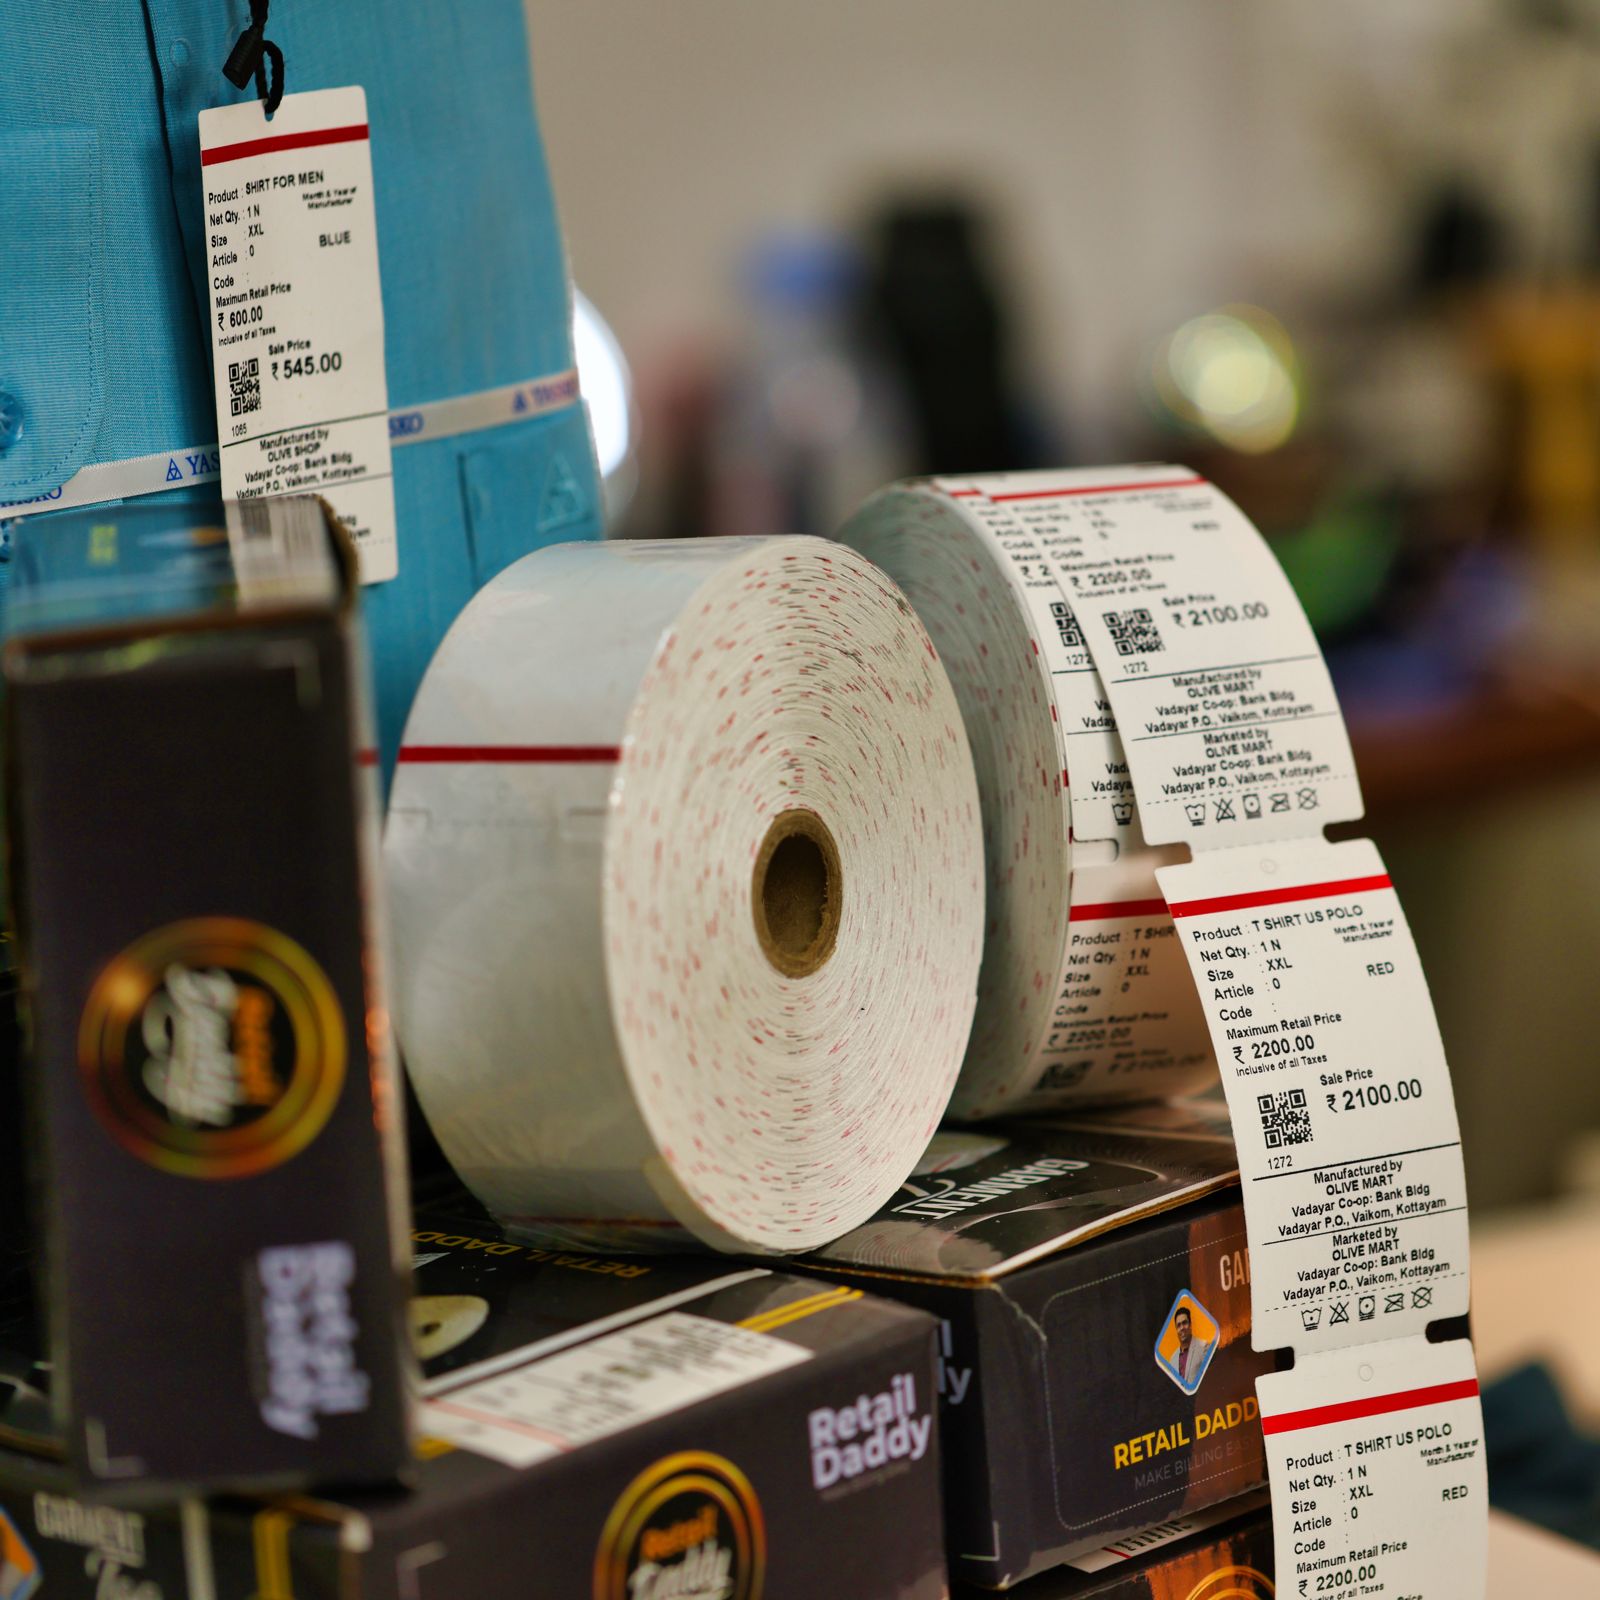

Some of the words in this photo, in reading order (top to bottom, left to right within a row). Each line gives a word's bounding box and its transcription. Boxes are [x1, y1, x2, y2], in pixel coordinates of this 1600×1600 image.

[209, 189, 238, 204] Product
[246, 178, 270, 195] SHIRT
[273, 175, 295, 188] FOR
[299, 171, 324, 185] MEN
[210, 213, 223, 226] Net
[225, 210, 240, 223] Qty.
[248, 207, 251, 218] 1
[254, 205, 260, 217] N
[211, 234, 227, 247] Size
[248, 225, 264, 238] XXL
[319, 231, 351, 247] BLUE
[213, 252, 237, 267] Article
[214, 273, 234, 289] Code
[216, 293, 247, 308] Maximum
[250, 286, 268, 300] Retail
[270, 283, 291, 294] Price
[230, 306, 262, 327] 600.00
[218, 333, 242, 346] Inclusive
[245, 331, 250, 340] of
[259, 326, 276, 335] Taxes
[268, 344, 284, 355] Sale
[287, 340, 311, 352] Price
[284, 352, 342, 379] 545.00
[232, 423, 247, 437] 1065
[260, 429, 315, 450] Manufactured
[318, 428, 329, 440] by
[268, 447, 291, 462] OLIVE
[295, 442, 320, 456] SHOP
[185, 452, 219, 476] YAS
[245, 467, 273, 483] Vadayar
[305, 456, 327, 469] Bank
[331, 452, 352, 464] Bldg
[236, 485, 263, 499] Vadayar
[322, 465, 366, 480] Kottayam
[1191, 602, 1269, 626] 2100.00
[1066, 654, 1090, 665] 1272
[1123, 662, 1149, 674] 1272
[1173, 670, 1246, 687] Manufactured
[1249, 668, 1261, 680] by
[1188, 685, 1221, 698] OLIVE
[1224, 681, 1254, 694] MART
[1156, 700, 1199, 716] Vadayar
[1241, 692, 1266, 705] Bank
[1270, 690, 1294, 702] Bldg
[1145, 718, 1188, 733] Vadayar
[1263, 703, 1314, 718] Kottayam
[1203, 729, 1253, 745] Marketed
[1256, 728, 1268, 740] by
[1206, 744, 1239, 758] OLIVE
[1242, 740, 1272, 753] MART
[1193, 926, 1242, 942] Product
[1252, 921, 1260, 932] T
[1264, 915, 1301, 930] SHIRT
[1305, 911, 1324, 924] US
[1327, 905, 1363, 920] POLO
[1072, 932, 1120, 946] Product
[1145, 925, 1175, 938] SHIR
[1343, 930, 1392, 943] Manufacturer
[1200, 950, 1223, 962] Net
[1225, 945, 1250, 959] Qty.
[1261, 943, 1266, 952] 1
[1270, 939, 1281, 950] N
[1065, 972, 1090, 983] Size
[1126, 966, 1149, 976] XXL
[1207, 969, 1234, 982] Size
[1266, 958, 1292, 971] XXL
[1366, 962, 1394, 976] RED
[1060, 987, 1100, 999] Article
[1214, 985, 1254, 1000] Article
[1219, 1006, 1252, 1021] Code
[1226, 1023, 1279, 1040] Maximum
[1281, 1017, 1312, 1031] Retail
[1314, 1012, 1341, 1025] Price
[1252, 1035, 1314, 1059] 2200.00
[1236, 1062, 1275, 1076] Inclusive
[1278, 1058, 1287, 1069] of
[1289, 1056, 1299, 1067] all
[1301, 1054, 1327, 1065] Taxes
[1320, 1074, 1342, 1085] Sale
[1346, 1068, 1373, 1081] Price
[1342, 1079, 1422, 1110] 2100.00
[1268, 1155, 1293, 1170] 1272
[1314, 1161, 1388, 1184] Manufactured
[1390, 1160, 1403, 1171] by
[900, 1158, 1089, 1219] GARMENT
[1326, 1180, 1359, 1196] OLIVE
[1362, 1174, 1394, 1189] MART
[1292, 1201, 1334, 1217] Vadayar
[1339, 1195, 1373, 1208] Co-op:
[1376, 1189, 1402, 1202] Bank
[1406, 1184, 1430, 1197] Bldg
[1278, 1218, 1321, 1237] Vadayar
[1325, 1215, 1349, 1229] P.O.,
[1352, 1207, 1394, 1223] Vaikom,
[1396, 1198, 1446, 1215] Kottayam
[410, 1229, 523, 1255] DADD
[1332, 1228, 1382, 1246] Marketed
[1385, 1226, 1398, 1238] by
[1332, 1245, 1364, 1261] OLIVE
[1368, 1239, 1399, 1254] MART
[526, 1250, 650, 1278] RETAIL
[1298, 1265, 1339, 1282] Vadayar
[1344, 1260, 1378, 1273] Co-op:
[1381, 1253, 1407, 1267] Bank
[1411, 1248, 1434, 1260] Bldg
[1284, 1284, 1326, 1301] Vadayar
[1329, 1280, 1353, 1292] P.O.,
[1356, 1272, 1397, 1288] Vaikom,
[1400, 1262, 1449, 1278] Kottayam
[808, 1373, 916, 1450] Retail
[1114, 1422, 1190, 1471] RETAIL
[1195, 1396, 1258, 1439] DADD
[812, 1415, 931, 1490] Daddy
[1287, 1451, 1333, 1470] Product
[1344, 1444, 1352, 1457] T
[1356, 1436, 1392, 1455] SHIRT
[1396, 1432, 1413, 1446] US
[1417, 1423, 1452, 1442] POLO
[1135, 1460, 1172, 1490] MAKE
[1175, 1445, 1223, 1474] BILLING
[1289, 1479, 1309, 1493] Net
[1314, 1474, 1336, 1489] Qty.
[1348, 1468, 1353, 1479] 1
[1358, 1465, 1367, 1477] N
[1292, 1499, 1316, 1514] Size
[1350, 1485, 1373, 1500] XXL
[1442, 1485, 1468, 1501] RED
[1293, 1515, 1331, 1533] Article
[1295, 1539, 1325, 1554] Code
[1296, 1554, 1346, 1573] Maximum
[1350, 1546, 1378, 1562] Retail
[1381, 1541, 1407, 1555] Price
[1316, 1564, 1376, 1591] 2200.00
[1360, 1583, 1384, 1594] Taxes
